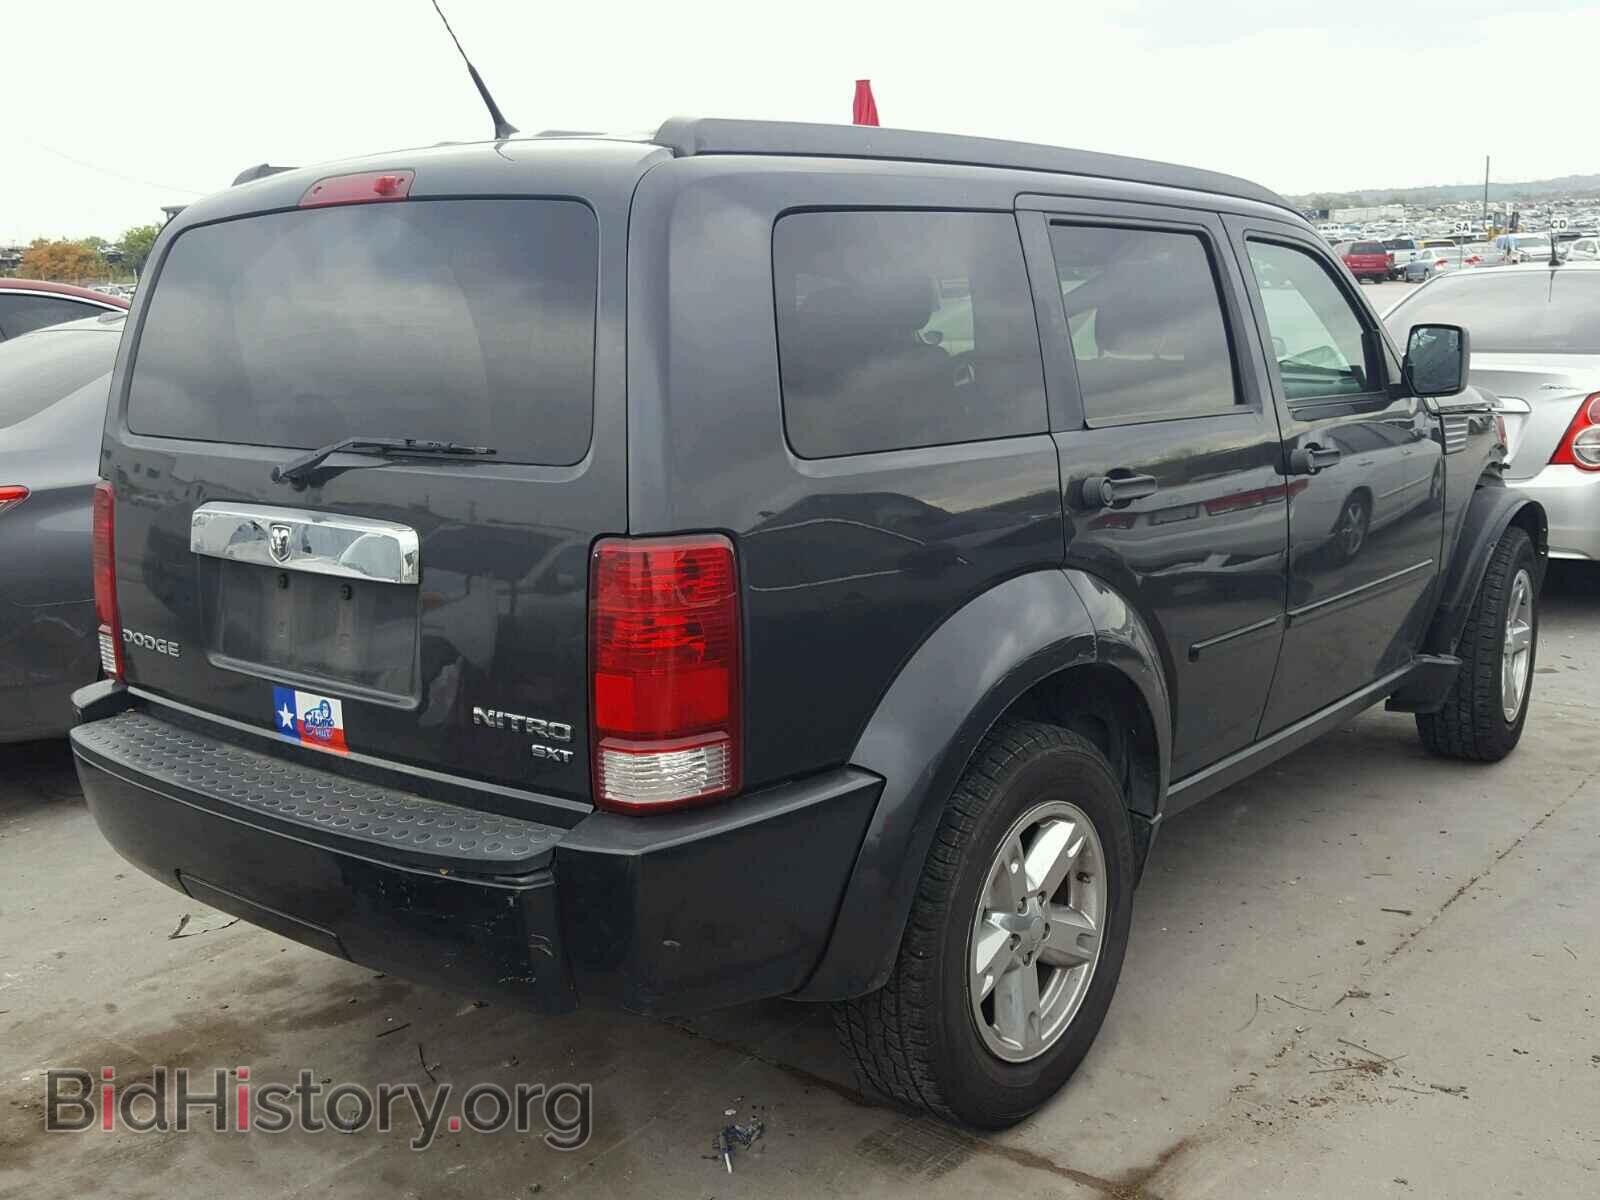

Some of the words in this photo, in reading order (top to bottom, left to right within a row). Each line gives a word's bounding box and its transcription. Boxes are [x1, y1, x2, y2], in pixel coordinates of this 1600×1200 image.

[1455, 222, 1470, 232] SA
[1551, 219, 1567, 229] CD
[122, 628, 180, 657] DODGE
[473, 707, 571, 741] NITRO
[531, 744, 574, 763] SXT
